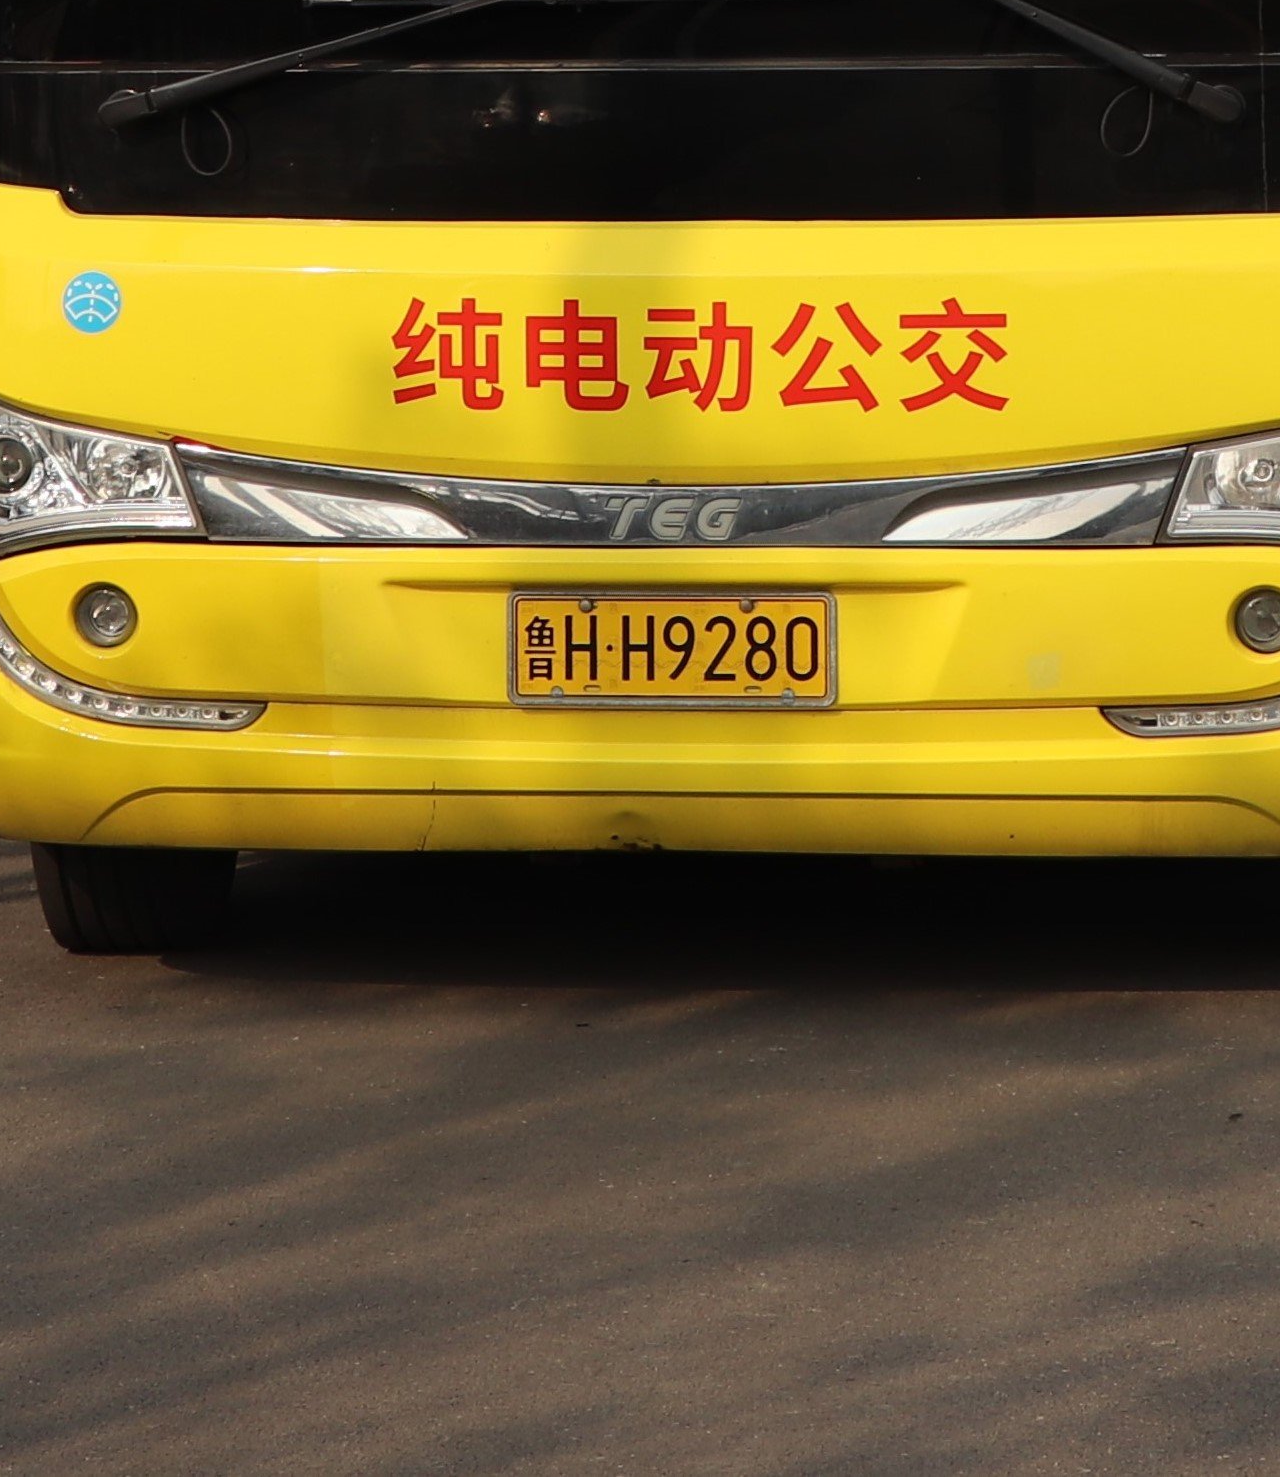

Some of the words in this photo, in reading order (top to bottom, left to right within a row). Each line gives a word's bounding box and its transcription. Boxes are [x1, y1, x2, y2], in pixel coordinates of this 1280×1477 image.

[392, 297, 1010, 413] 纯电动公交
[605, 496, 743, 540] TEG
